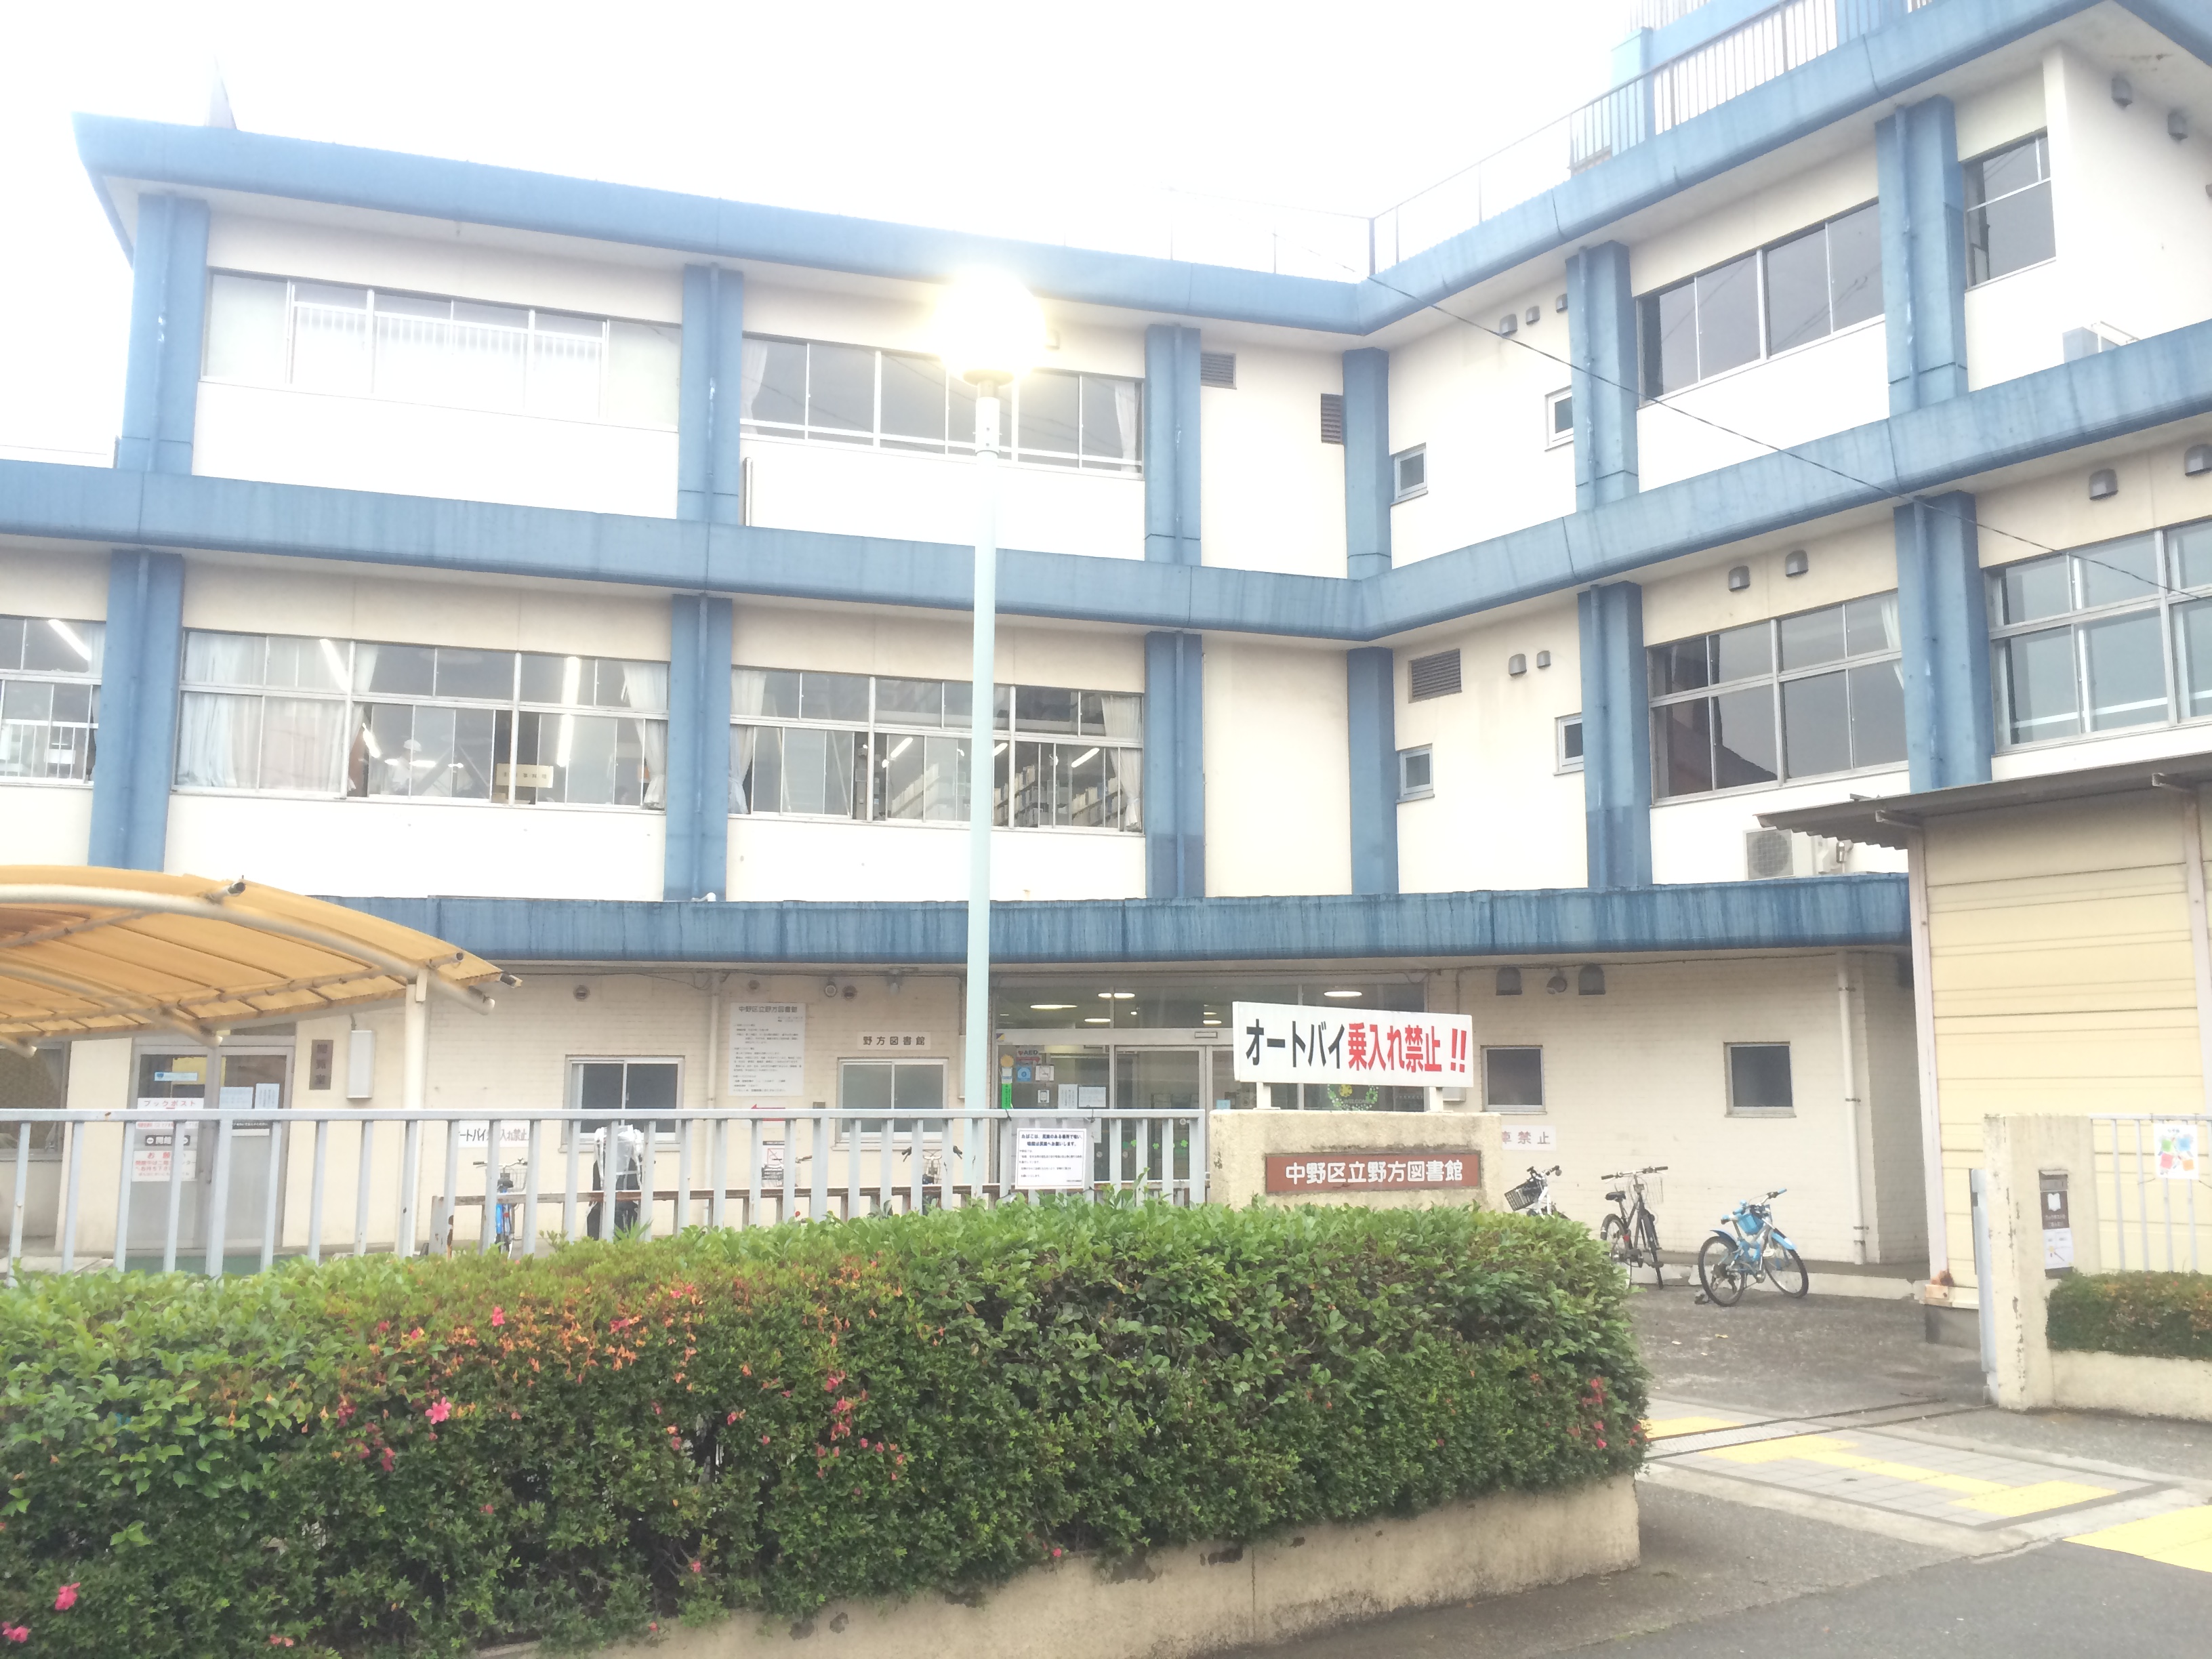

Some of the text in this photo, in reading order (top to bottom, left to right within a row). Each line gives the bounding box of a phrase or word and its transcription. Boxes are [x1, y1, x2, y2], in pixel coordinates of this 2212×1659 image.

[863, 1036, 926, 1046] 野方図書館
[1501, 1130, 1551, 1144] 車禁止
[1286, 1159, 1464, 1185] 中野区立野方図書館
